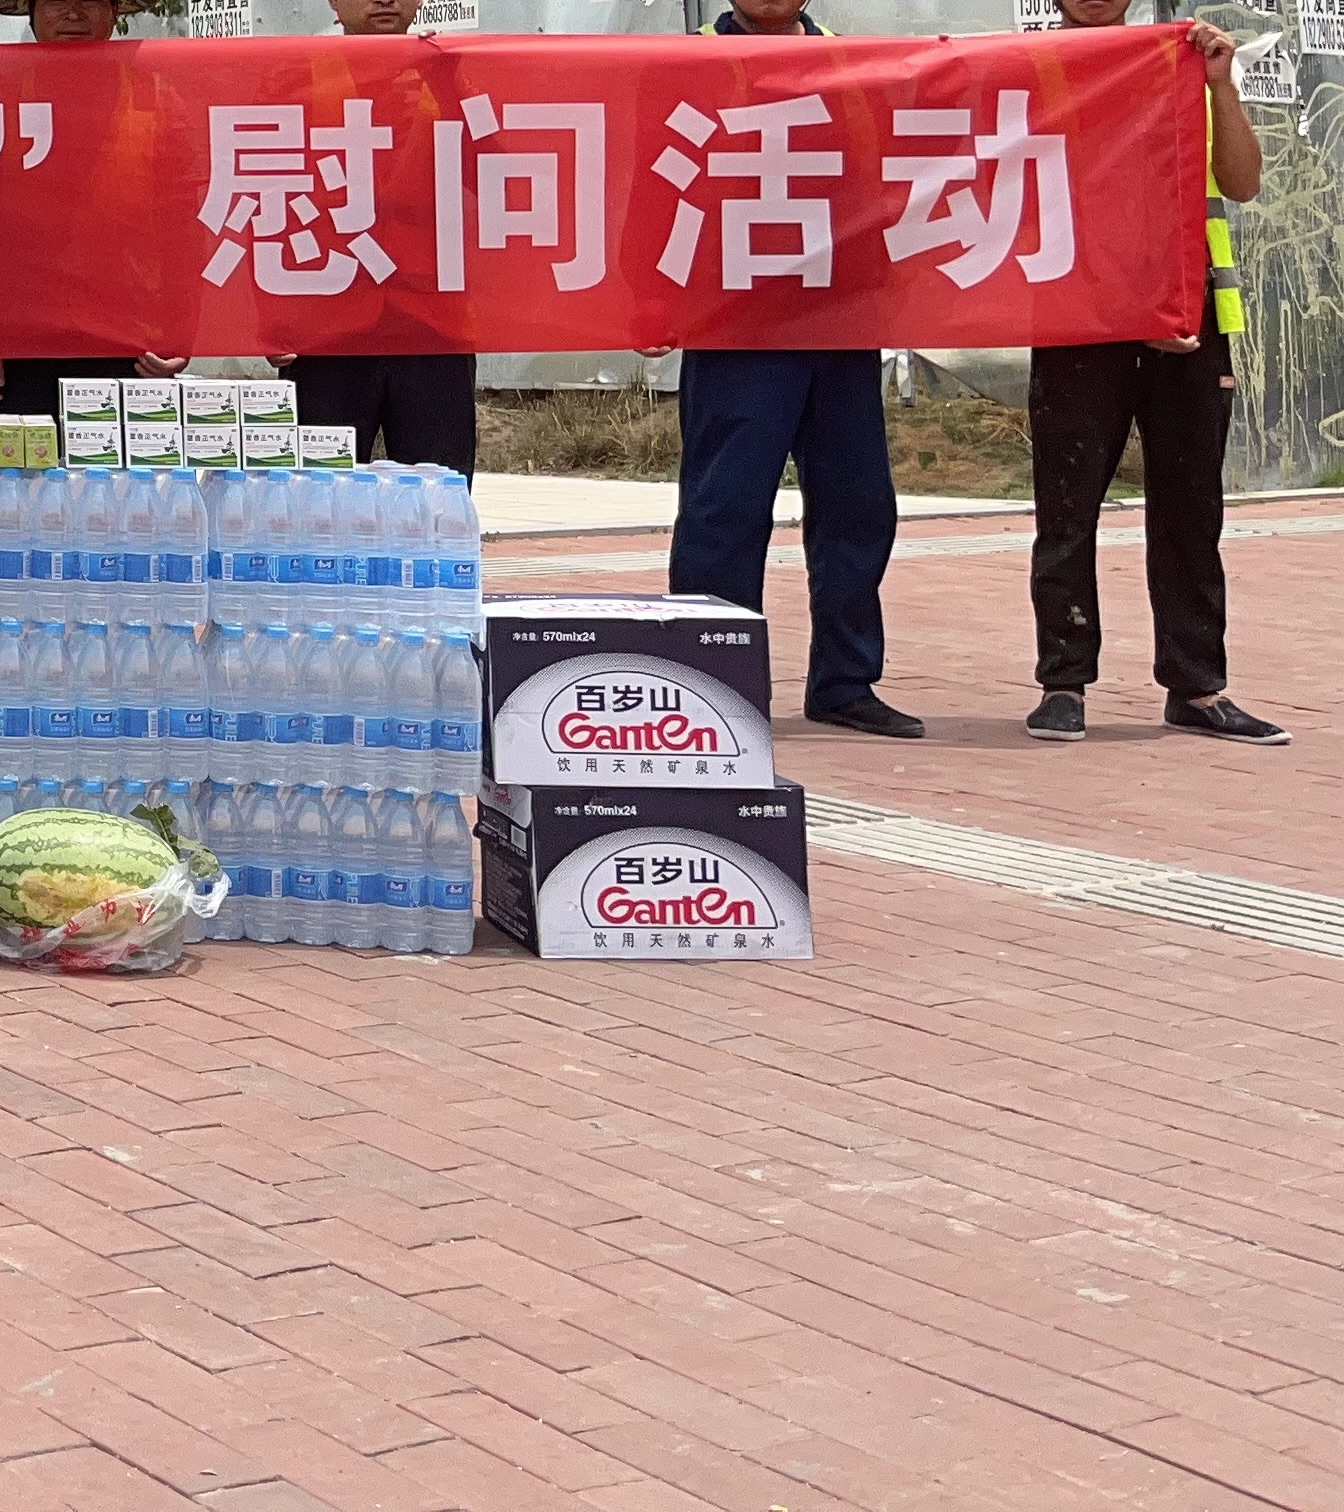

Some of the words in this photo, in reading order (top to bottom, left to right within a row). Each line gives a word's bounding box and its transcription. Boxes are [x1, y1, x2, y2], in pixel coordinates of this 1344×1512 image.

[196, 89, 1076, 297] 慰问活动
[575, 684, 681, 713] 百岁山
[557, 757, 738, 776] 饮用天然矿泉水
[614, 855, 720, 886] 百岁山
[592, 931, 776, 949] 饮用天然矿泉水
